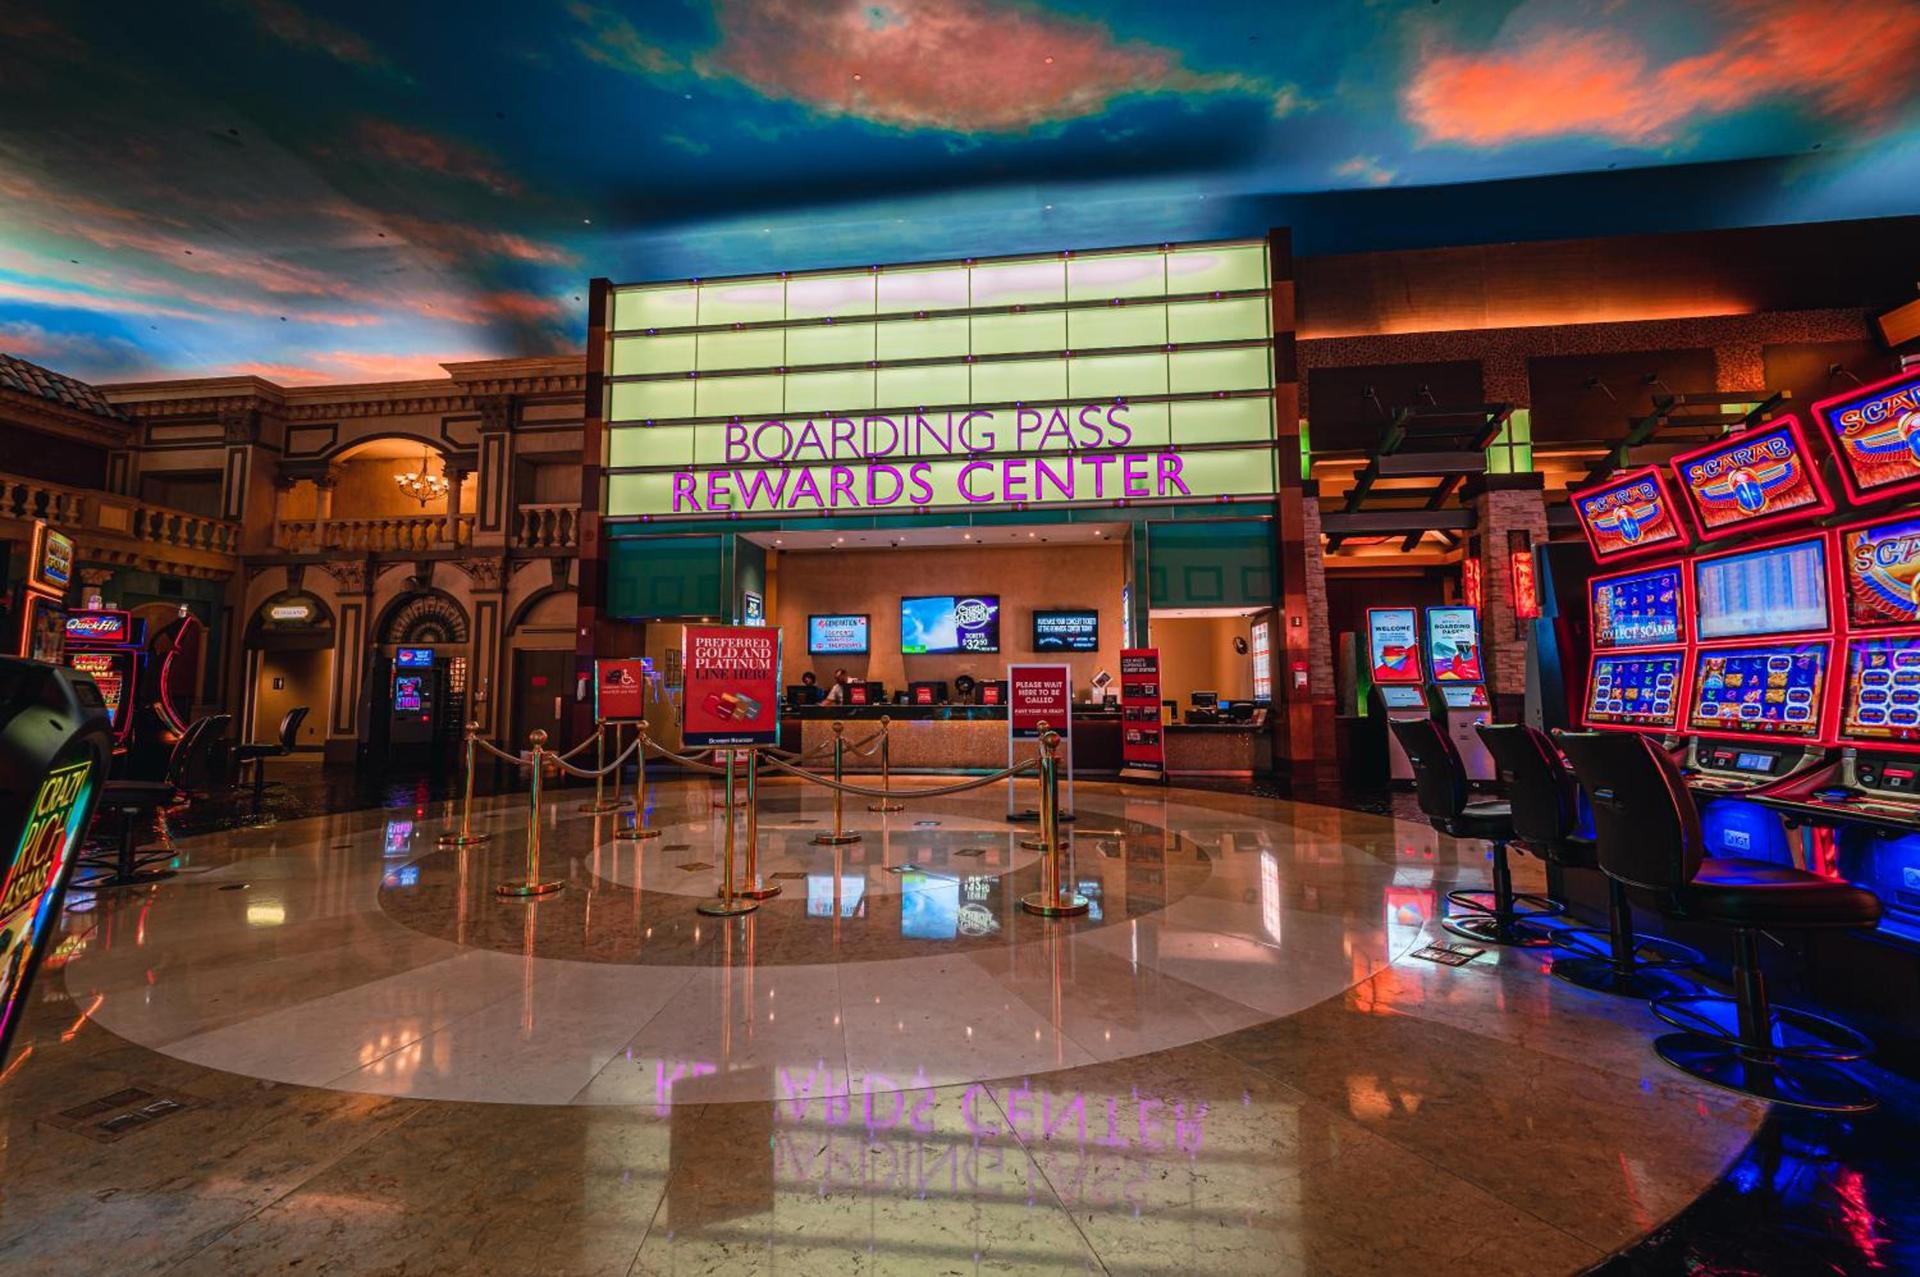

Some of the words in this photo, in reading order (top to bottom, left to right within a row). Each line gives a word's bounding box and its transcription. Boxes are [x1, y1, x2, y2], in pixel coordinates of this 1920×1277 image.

[725, 410, 996, 463] BOARDING
[1017, 404, 1132, 451] PASS
[672, 462, 934, 512] REWARDS
[957, 452, 1191, 502] CENTER
[1689, 437, 1791, 485] SCARAB
[1585, 482, 1657, 519] SCARAB
[66, 618, 99, 630] Quick
[1602, 622, 1638, 640] COLLECT
[1640, 621, 1675, 637] SCARABS
[695, 659, 771, 669] PLATINUM
[695, 669, 729, 679] LINE
[733, 669, 768, 679] HERE
[742, 648, 771, 658] AND
[37, 766, 90, 817] CRAZY
[13, 807, 73, 879] RICH
[0, 861, 51, 916] ASIANS
